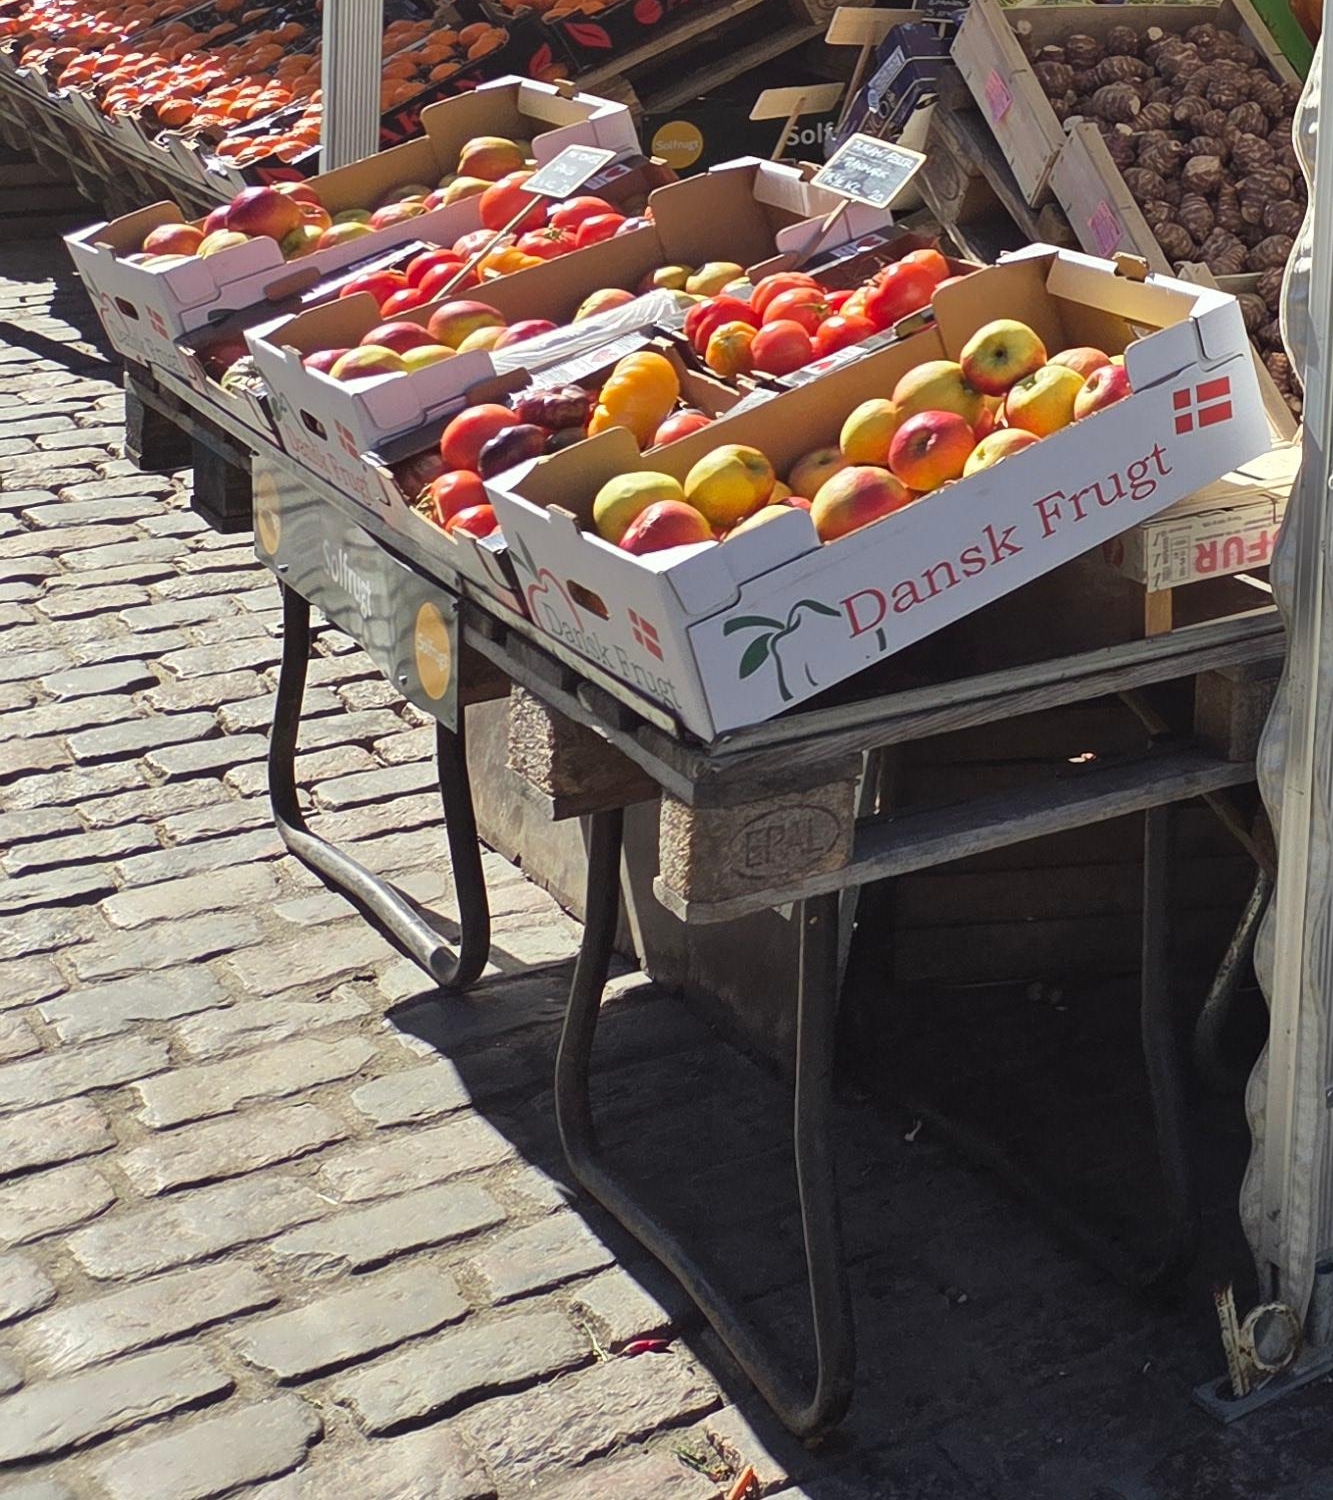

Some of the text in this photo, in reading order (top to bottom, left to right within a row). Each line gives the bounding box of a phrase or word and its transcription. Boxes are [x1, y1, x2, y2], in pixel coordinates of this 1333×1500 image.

[655, 139, 699, 151] Solfrugt
[323, 539, 372, 619] Solfrugt
[838, 443, 1173, 639] Dansk Frugt
[542, 602, 682, 710] Dansk Frugt
